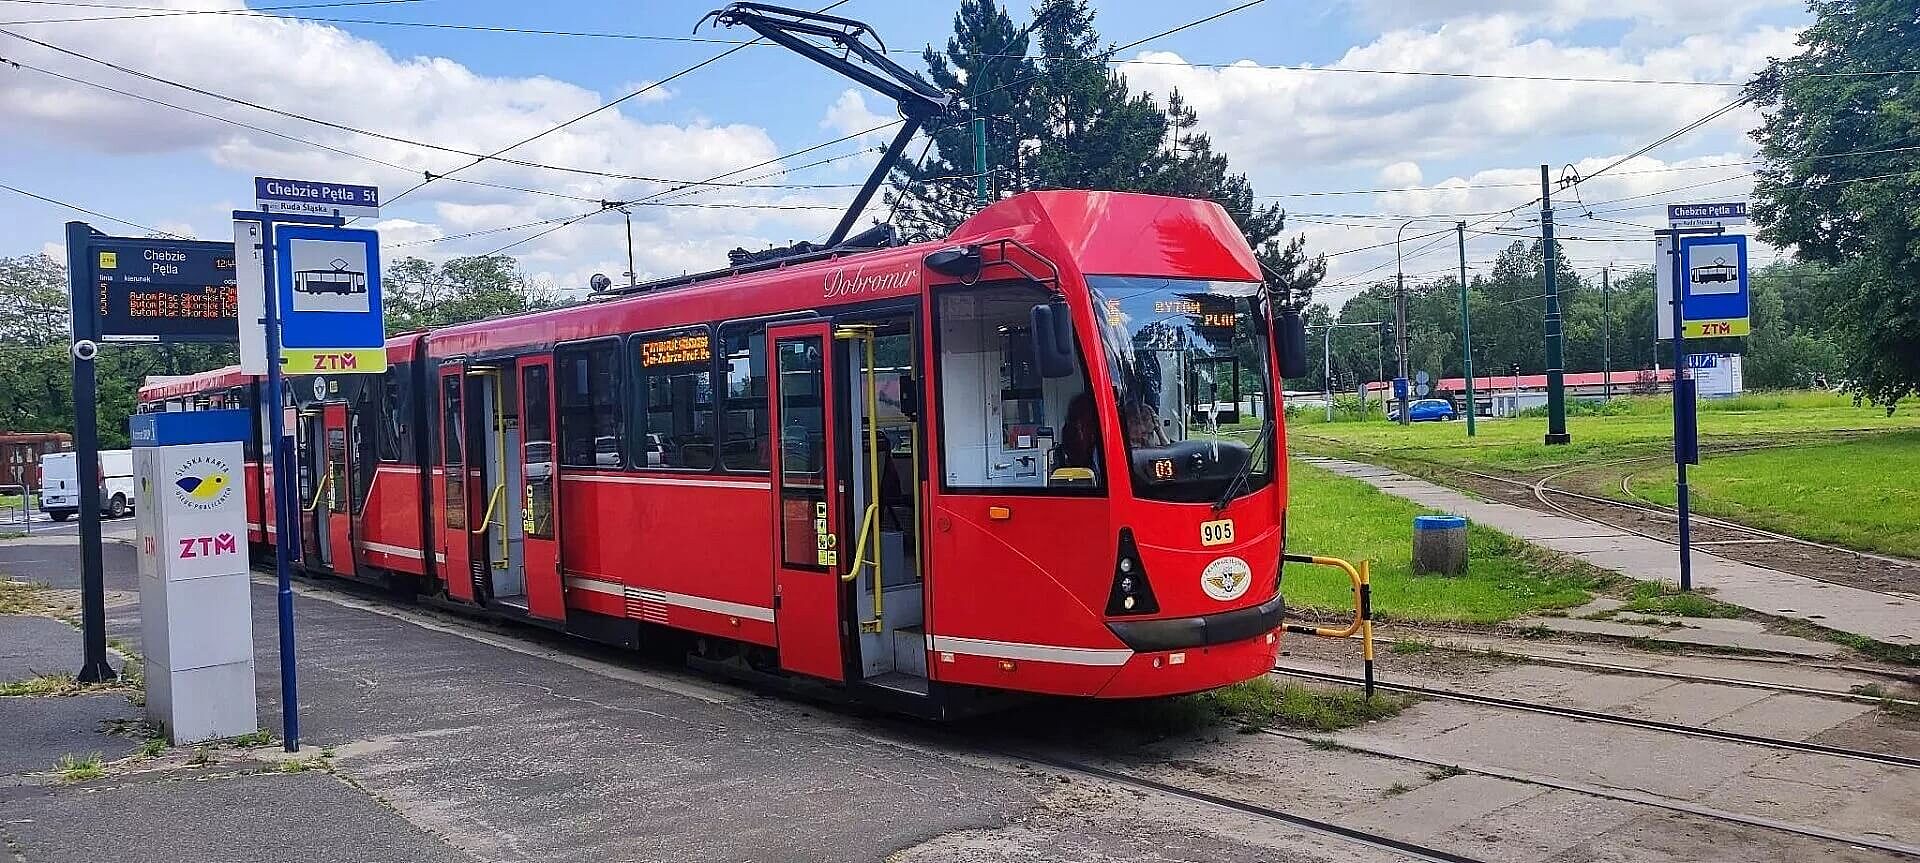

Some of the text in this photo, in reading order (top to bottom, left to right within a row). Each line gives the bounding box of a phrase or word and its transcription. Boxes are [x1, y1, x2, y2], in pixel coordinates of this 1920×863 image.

[266, 182, 376, 202] Chebzie Pętla 5t
[280, 202, 301, 211] Ruda
[1674, 207, 1707, 217] Chebzie
[1709, 206, 1730, 216] Pętla
[143, 249, 187, 262] Chebzie
[152, 263, 178, 276] Pętla
[824, 265, 918, 298] Dobromir
[1702, 323, 1730, 335] ZTM
[313, 353, 357, 370] ZTM
[643, 343, 650, 368] 5
[1155, 460, 1173, 478] 03
[1204, 523, 1232, 542] 905
[179, 532, 236, 559] ZTM
